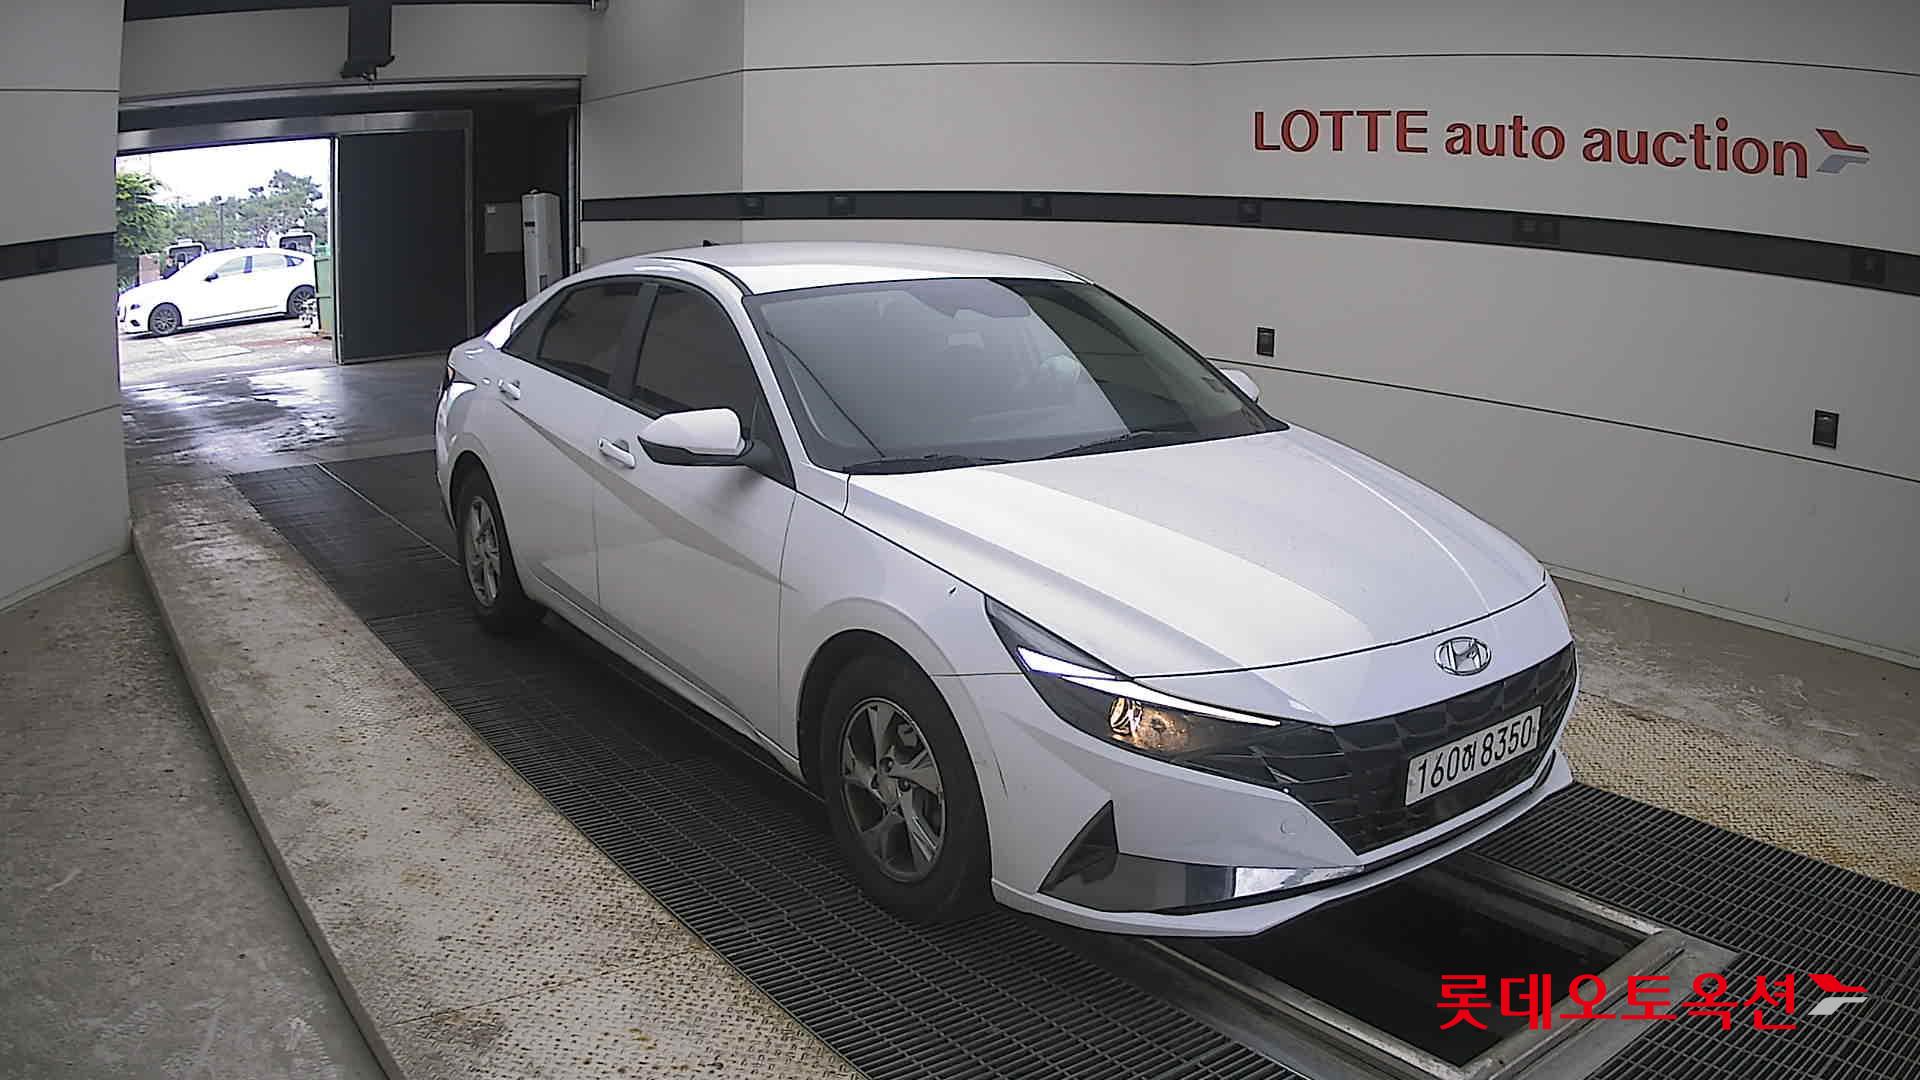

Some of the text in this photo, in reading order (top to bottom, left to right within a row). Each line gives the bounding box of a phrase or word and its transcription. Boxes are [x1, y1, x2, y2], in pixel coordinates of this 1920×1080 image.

[1254, 110, 1808, 178] LOTTE auto auction
